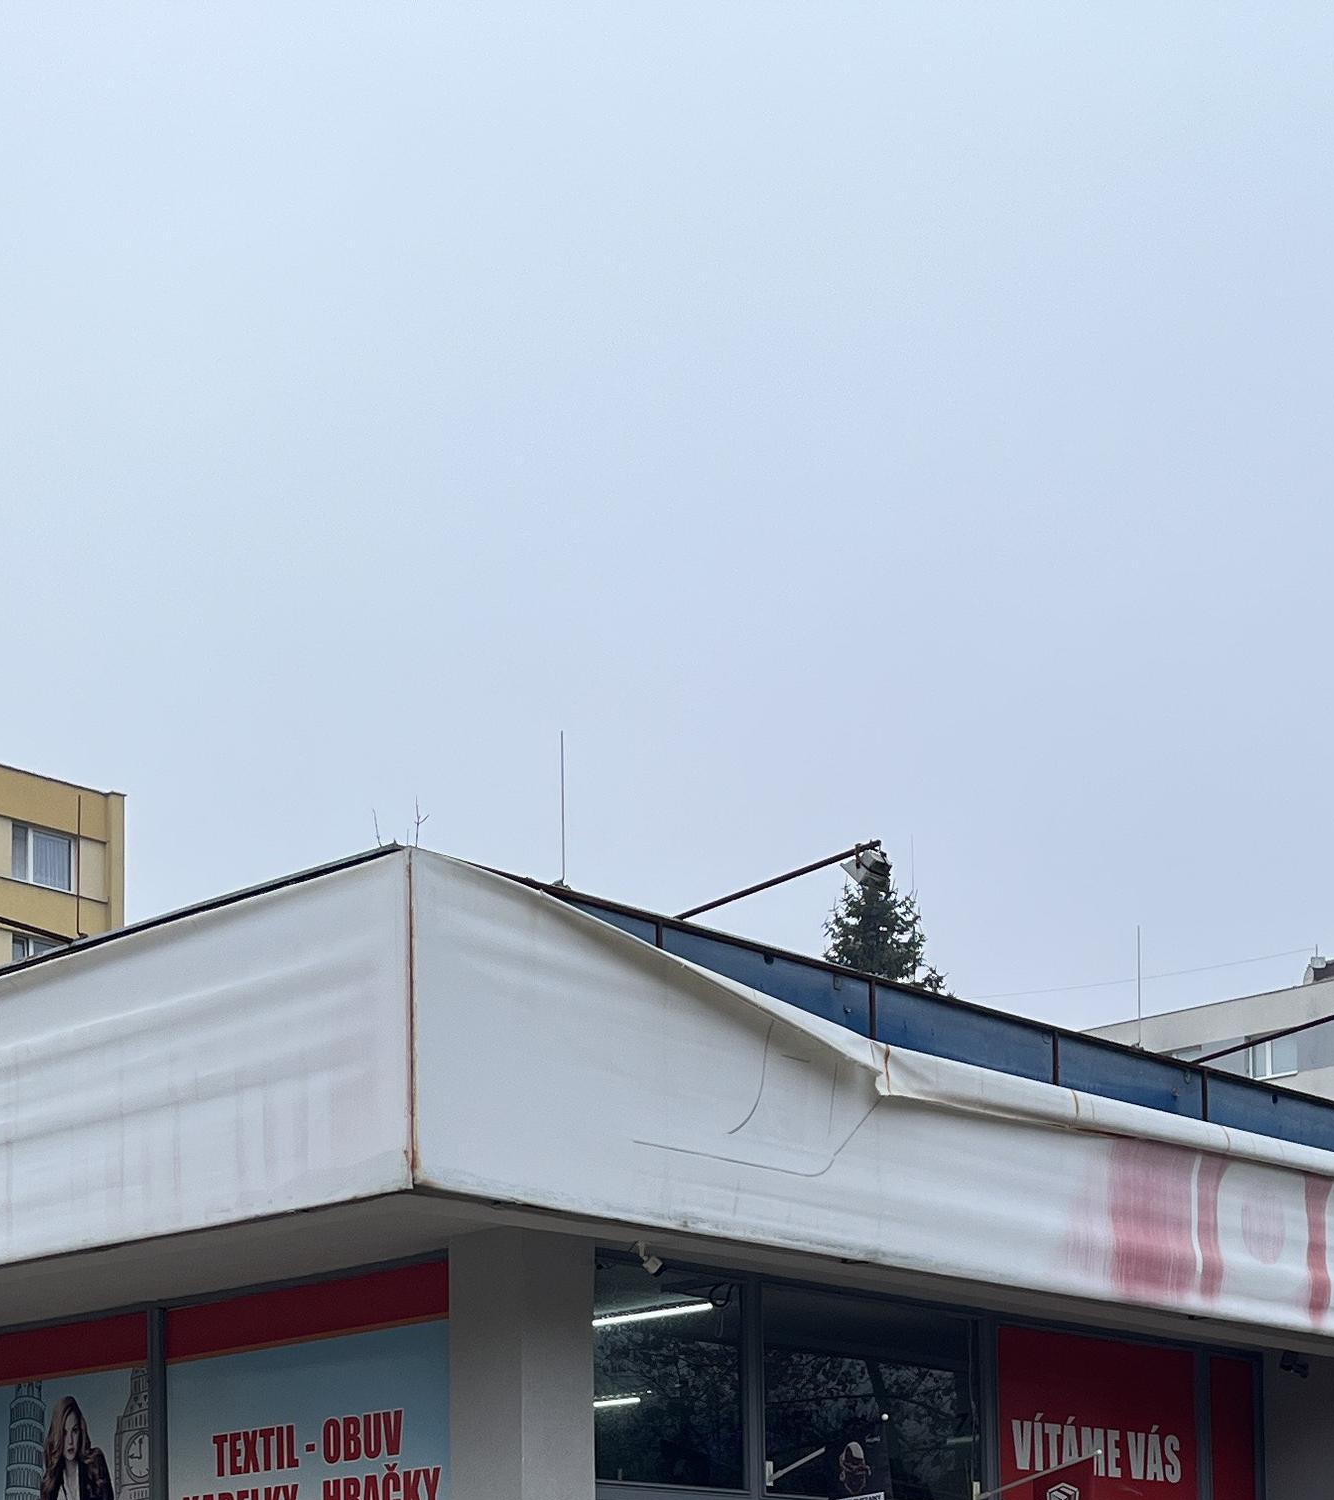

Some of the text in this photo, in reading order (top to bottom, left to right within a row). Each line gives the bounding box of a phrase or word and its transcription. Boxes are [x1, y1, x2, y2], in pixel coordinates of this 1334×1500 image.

[213, 1425, 299, 1477] TEXTIL
[323, 1409, 403, 1464] OBUV
[1012, 1412, 1181, 1483] VÍTÁME VÁS
